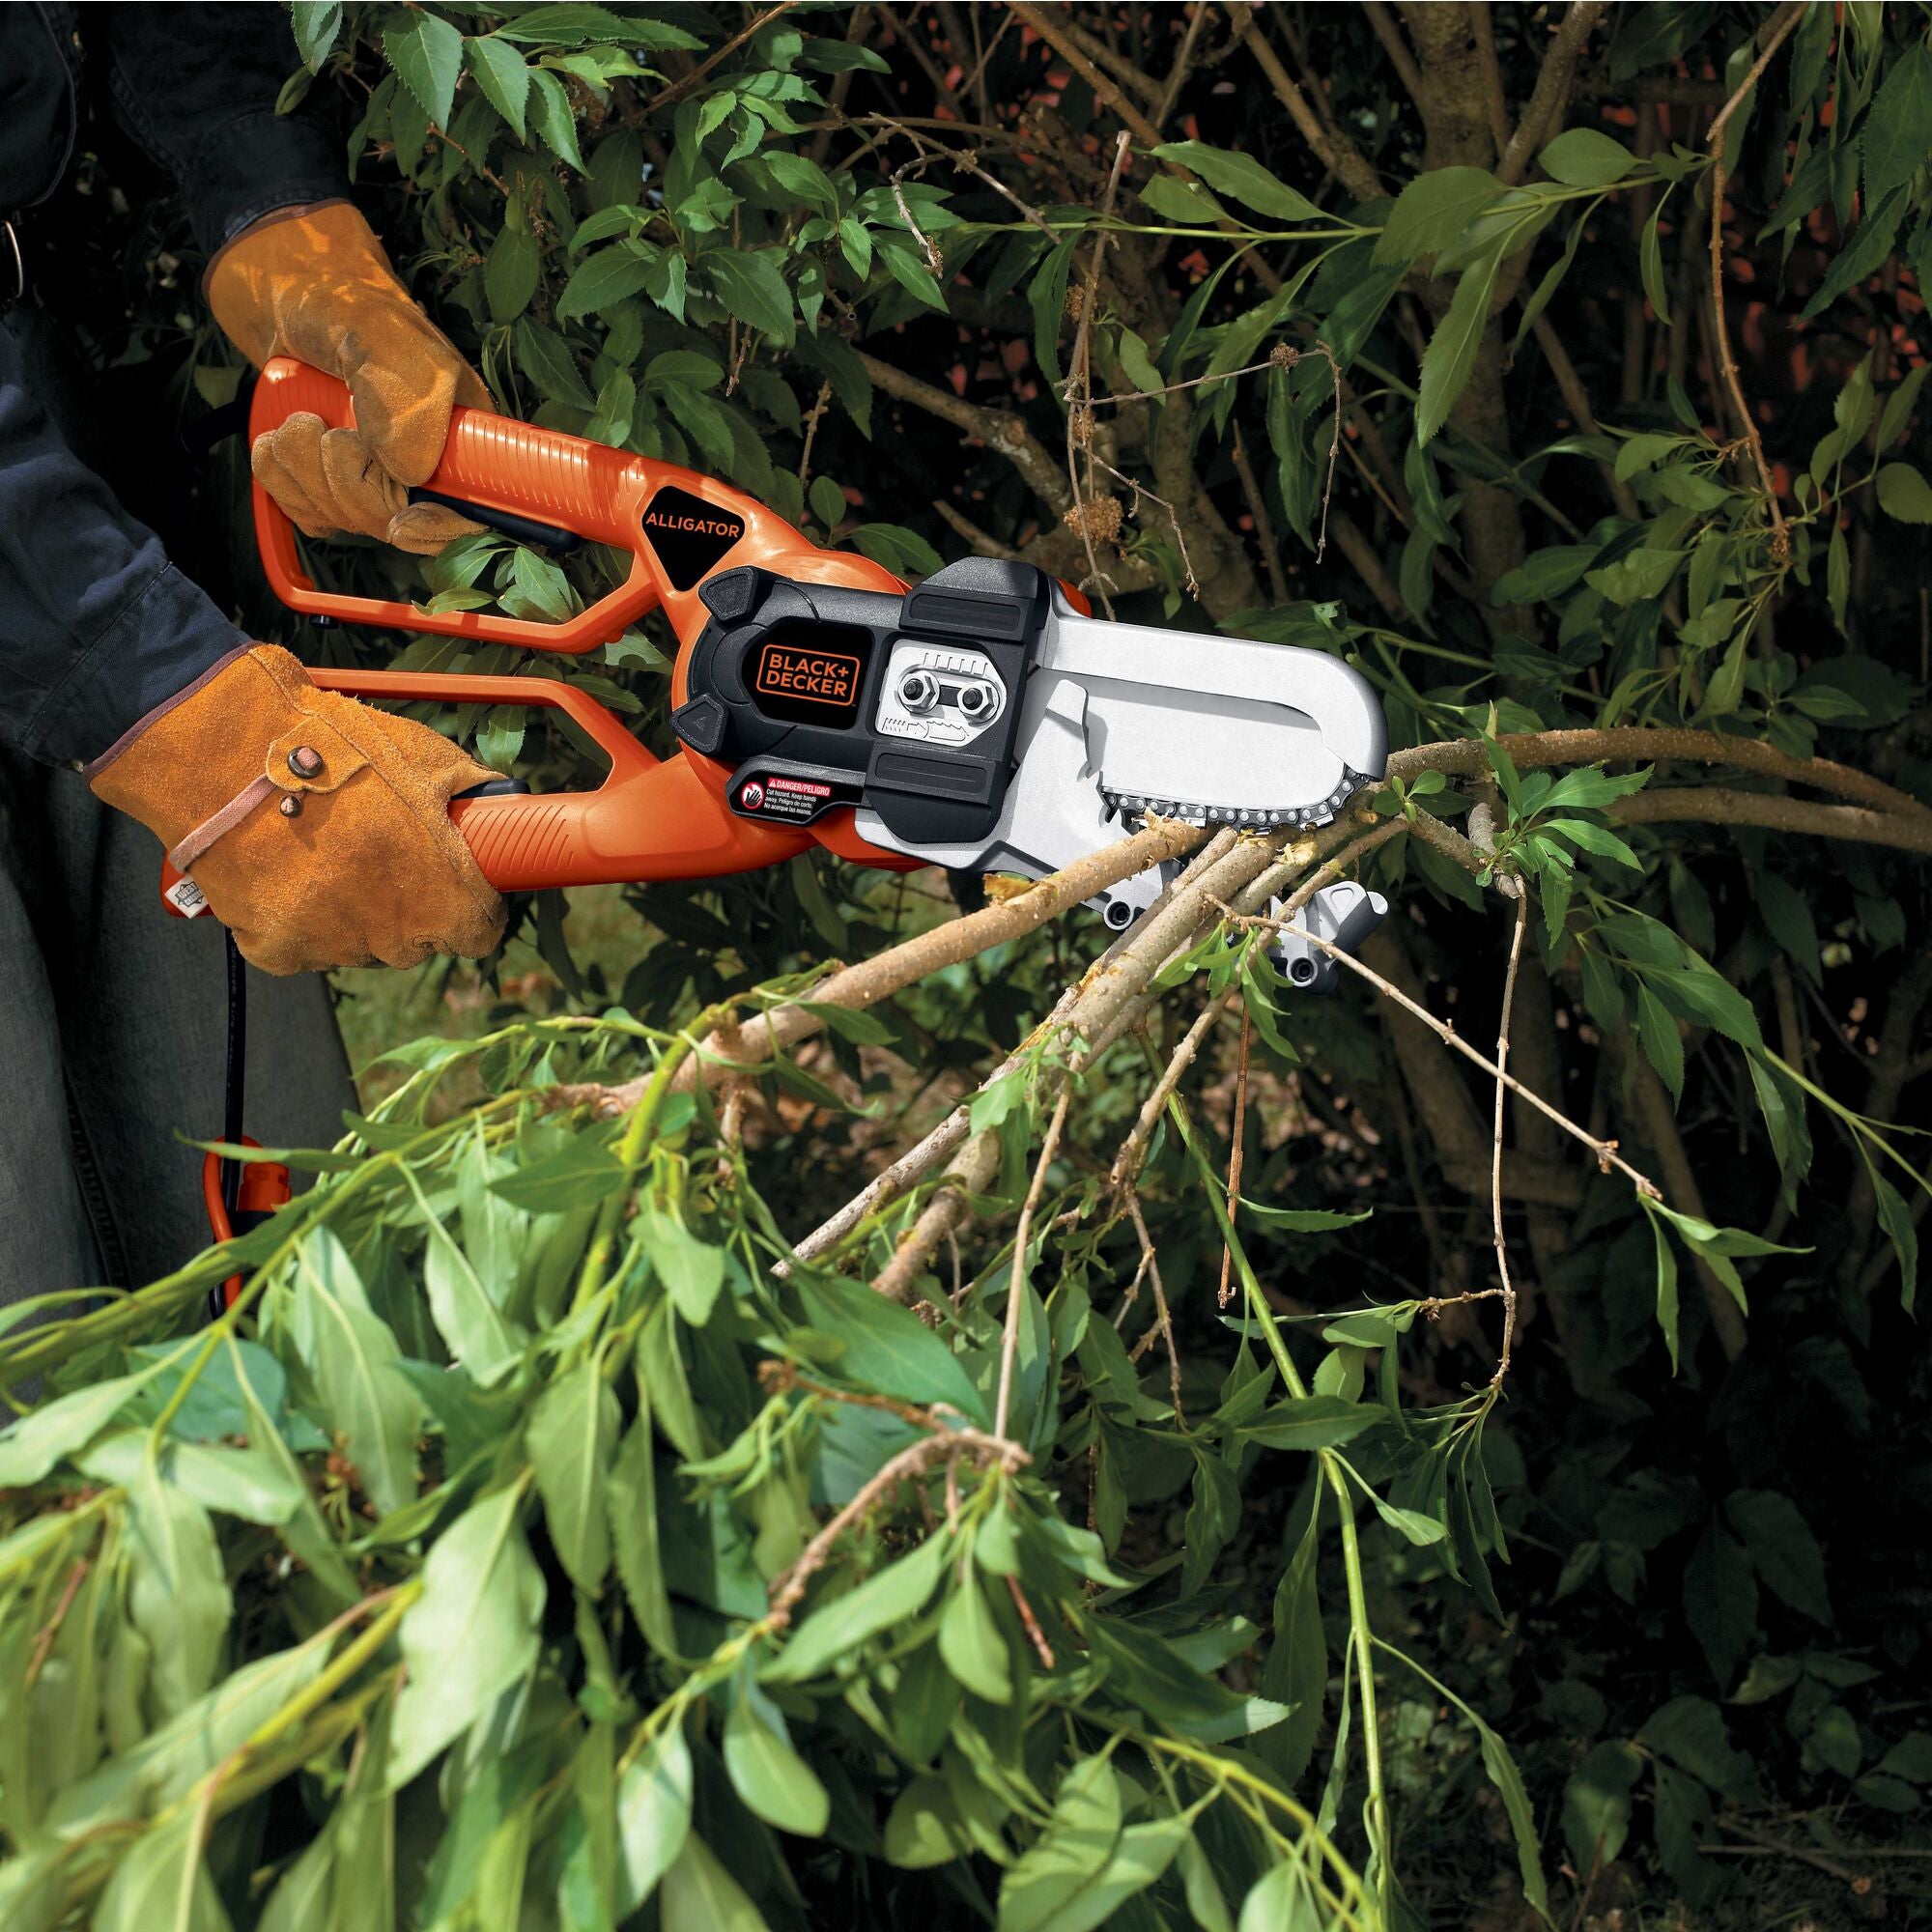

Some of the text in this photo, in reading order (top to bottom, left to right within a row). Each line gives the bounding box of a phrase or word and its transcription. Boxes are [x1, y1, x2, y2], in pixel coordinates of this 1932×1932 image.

[646, 512, 740, 538] ALLIGATOR
[769, 653, 849, 678] BLACK+
[766, 669, 847, 696] DECKER
[777, 780, 830, 796] DANGER/PELIGRO
[778, 797, 794, 806] Peligro
